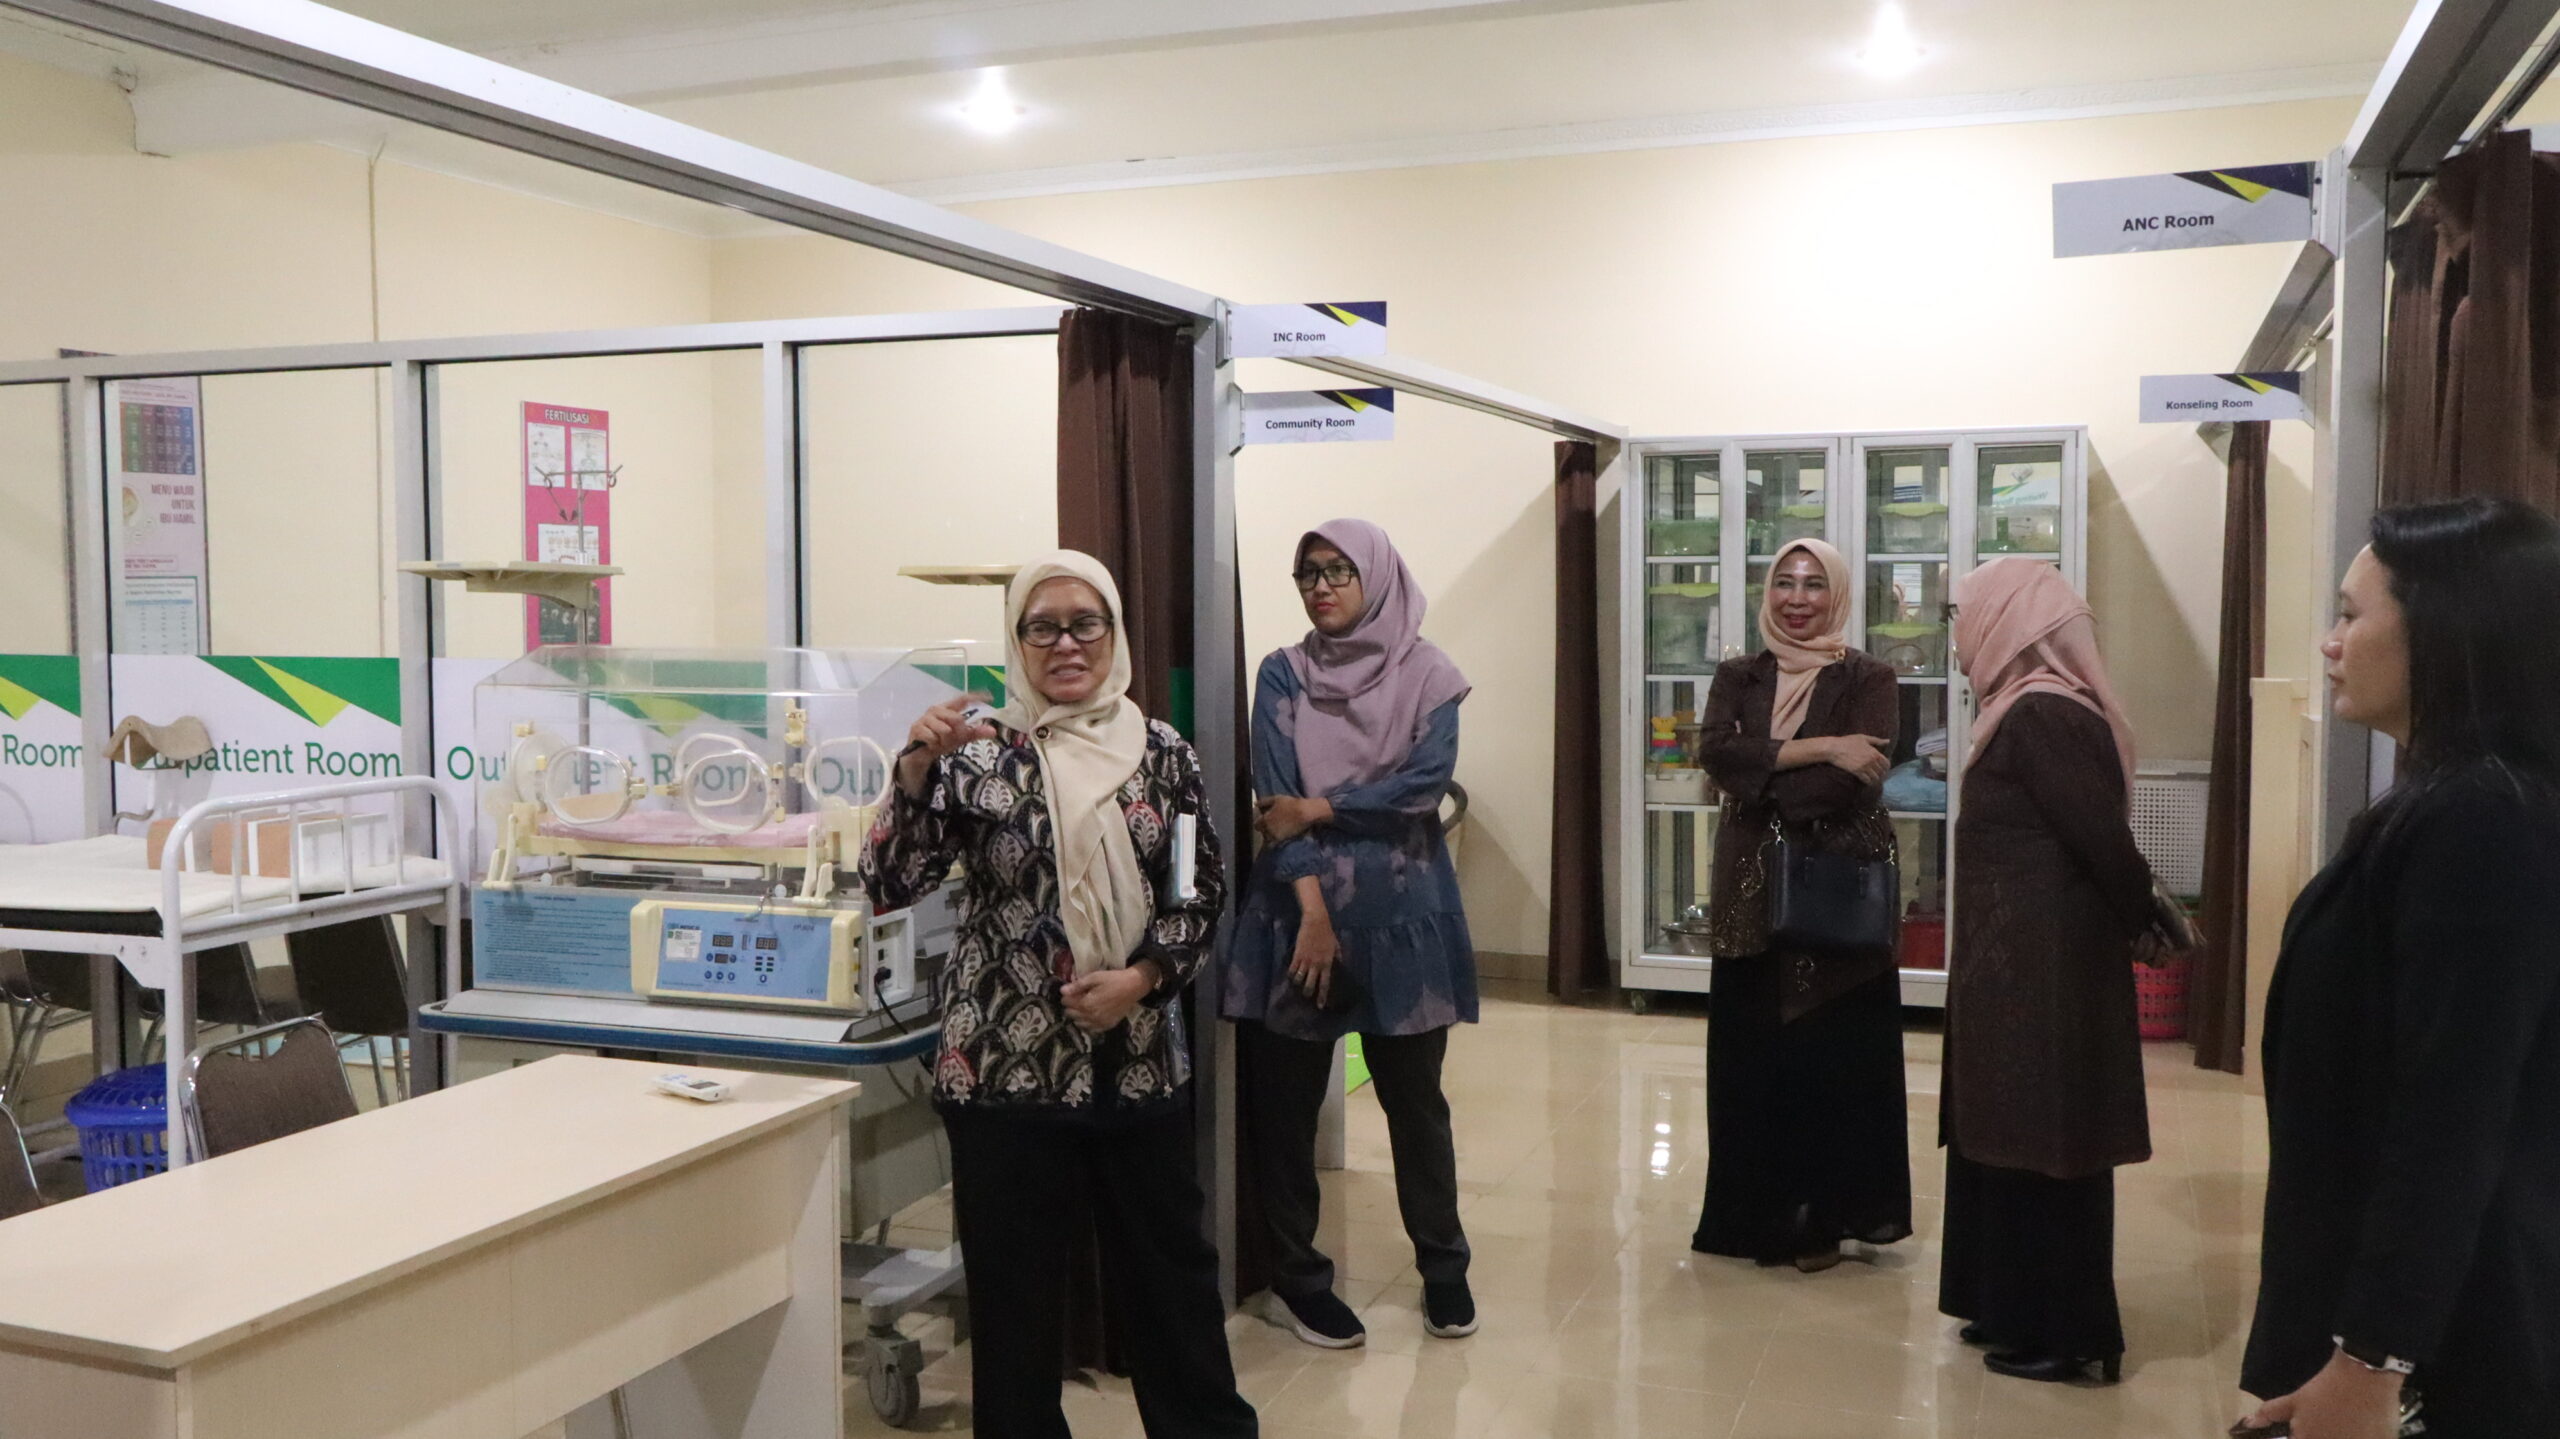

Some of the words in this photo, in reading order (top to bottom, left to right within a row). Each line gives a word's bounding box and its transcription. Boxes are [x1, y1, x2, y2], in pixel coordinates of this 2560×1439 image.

[2122, 216, 2160, 232] ANC
[2164, 213, 2215, 228] Room
[1273, 332, 1293, 342] INC
[1295, 332, 1326, 342] Room
[2165, 399, 2219, 411] Konseling
[2221, 399, 2253, 409] Room
[544, 408, 590, 424] FERTILISASI
[1265, 418, 1323, 430] Community
[1325, 418, 1355, 428] Room
[151, 484, 172, 495] MENU
[171, 499, 195, 510] UNTUK
[2, 734, 82, 767] Room
[305, 742, 402, 778] Room
